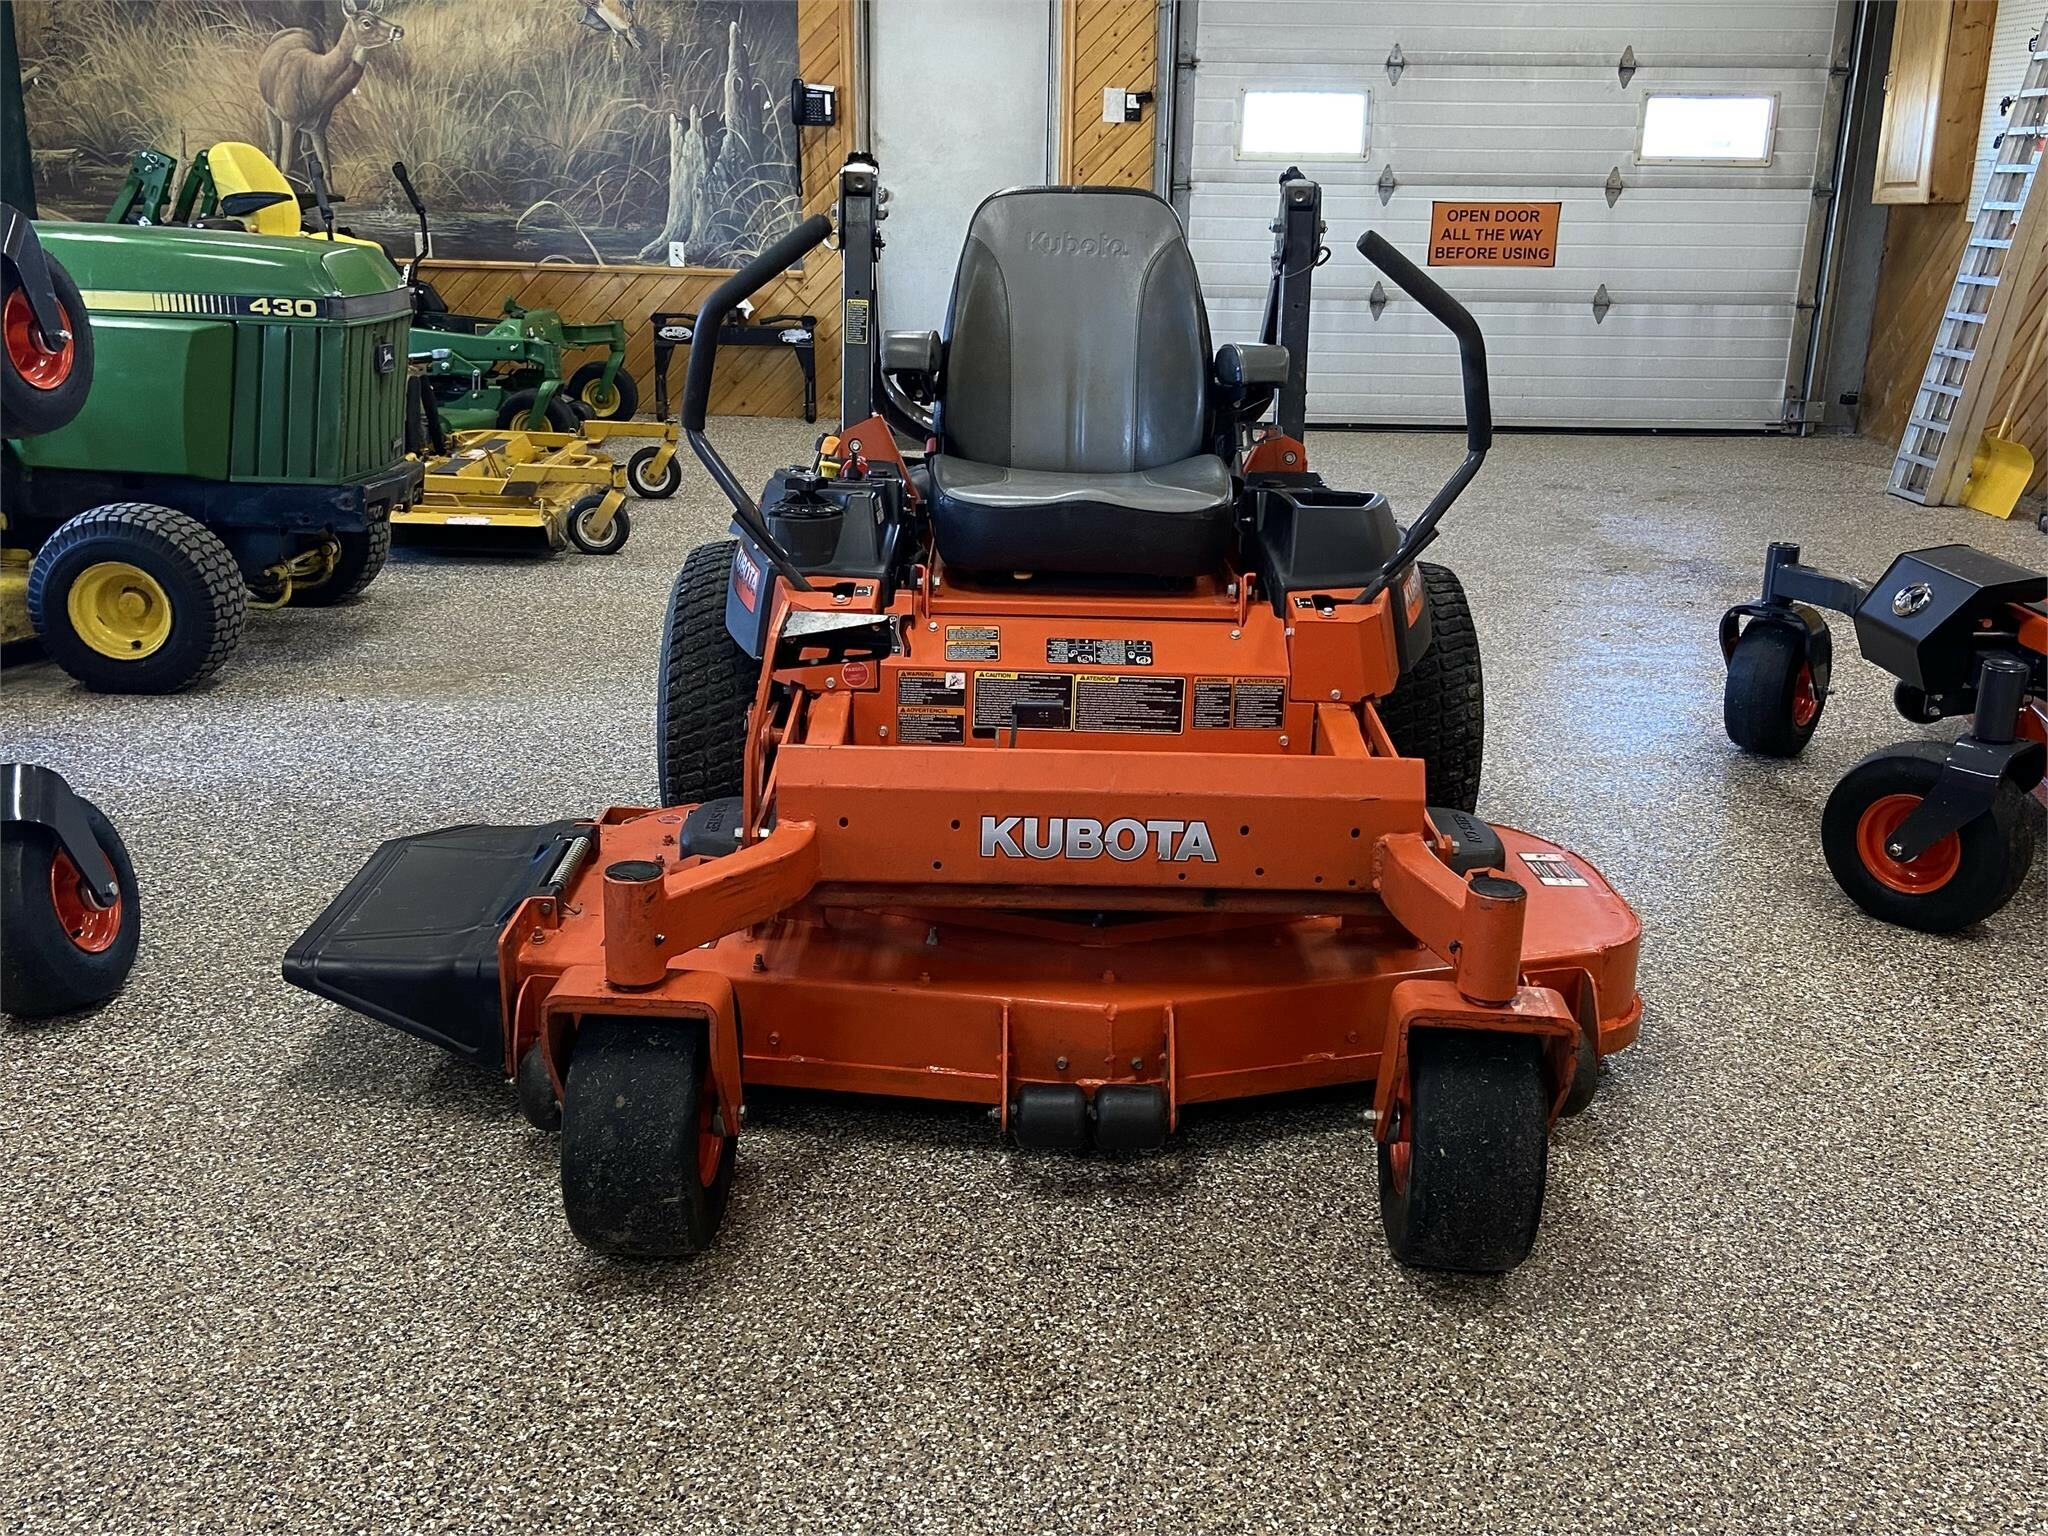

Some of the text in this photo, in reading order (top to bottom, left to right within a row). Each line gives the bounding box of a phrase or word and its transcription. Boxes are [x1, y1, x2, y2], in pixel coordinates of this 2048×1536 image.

[1447, 209, 1540, 223] OPEN DOOR
[1441, 227, 1543, 242] ALL THE WAY
[1026, 230, 1130, 259] Kubota
[1435, 246, 1550, 260] BEFORE USING
[249, 296, 318, 318] 430
[984, 671, 1012, 679] CAUTION
[980, 815, 1219, 863] KUBOTA
